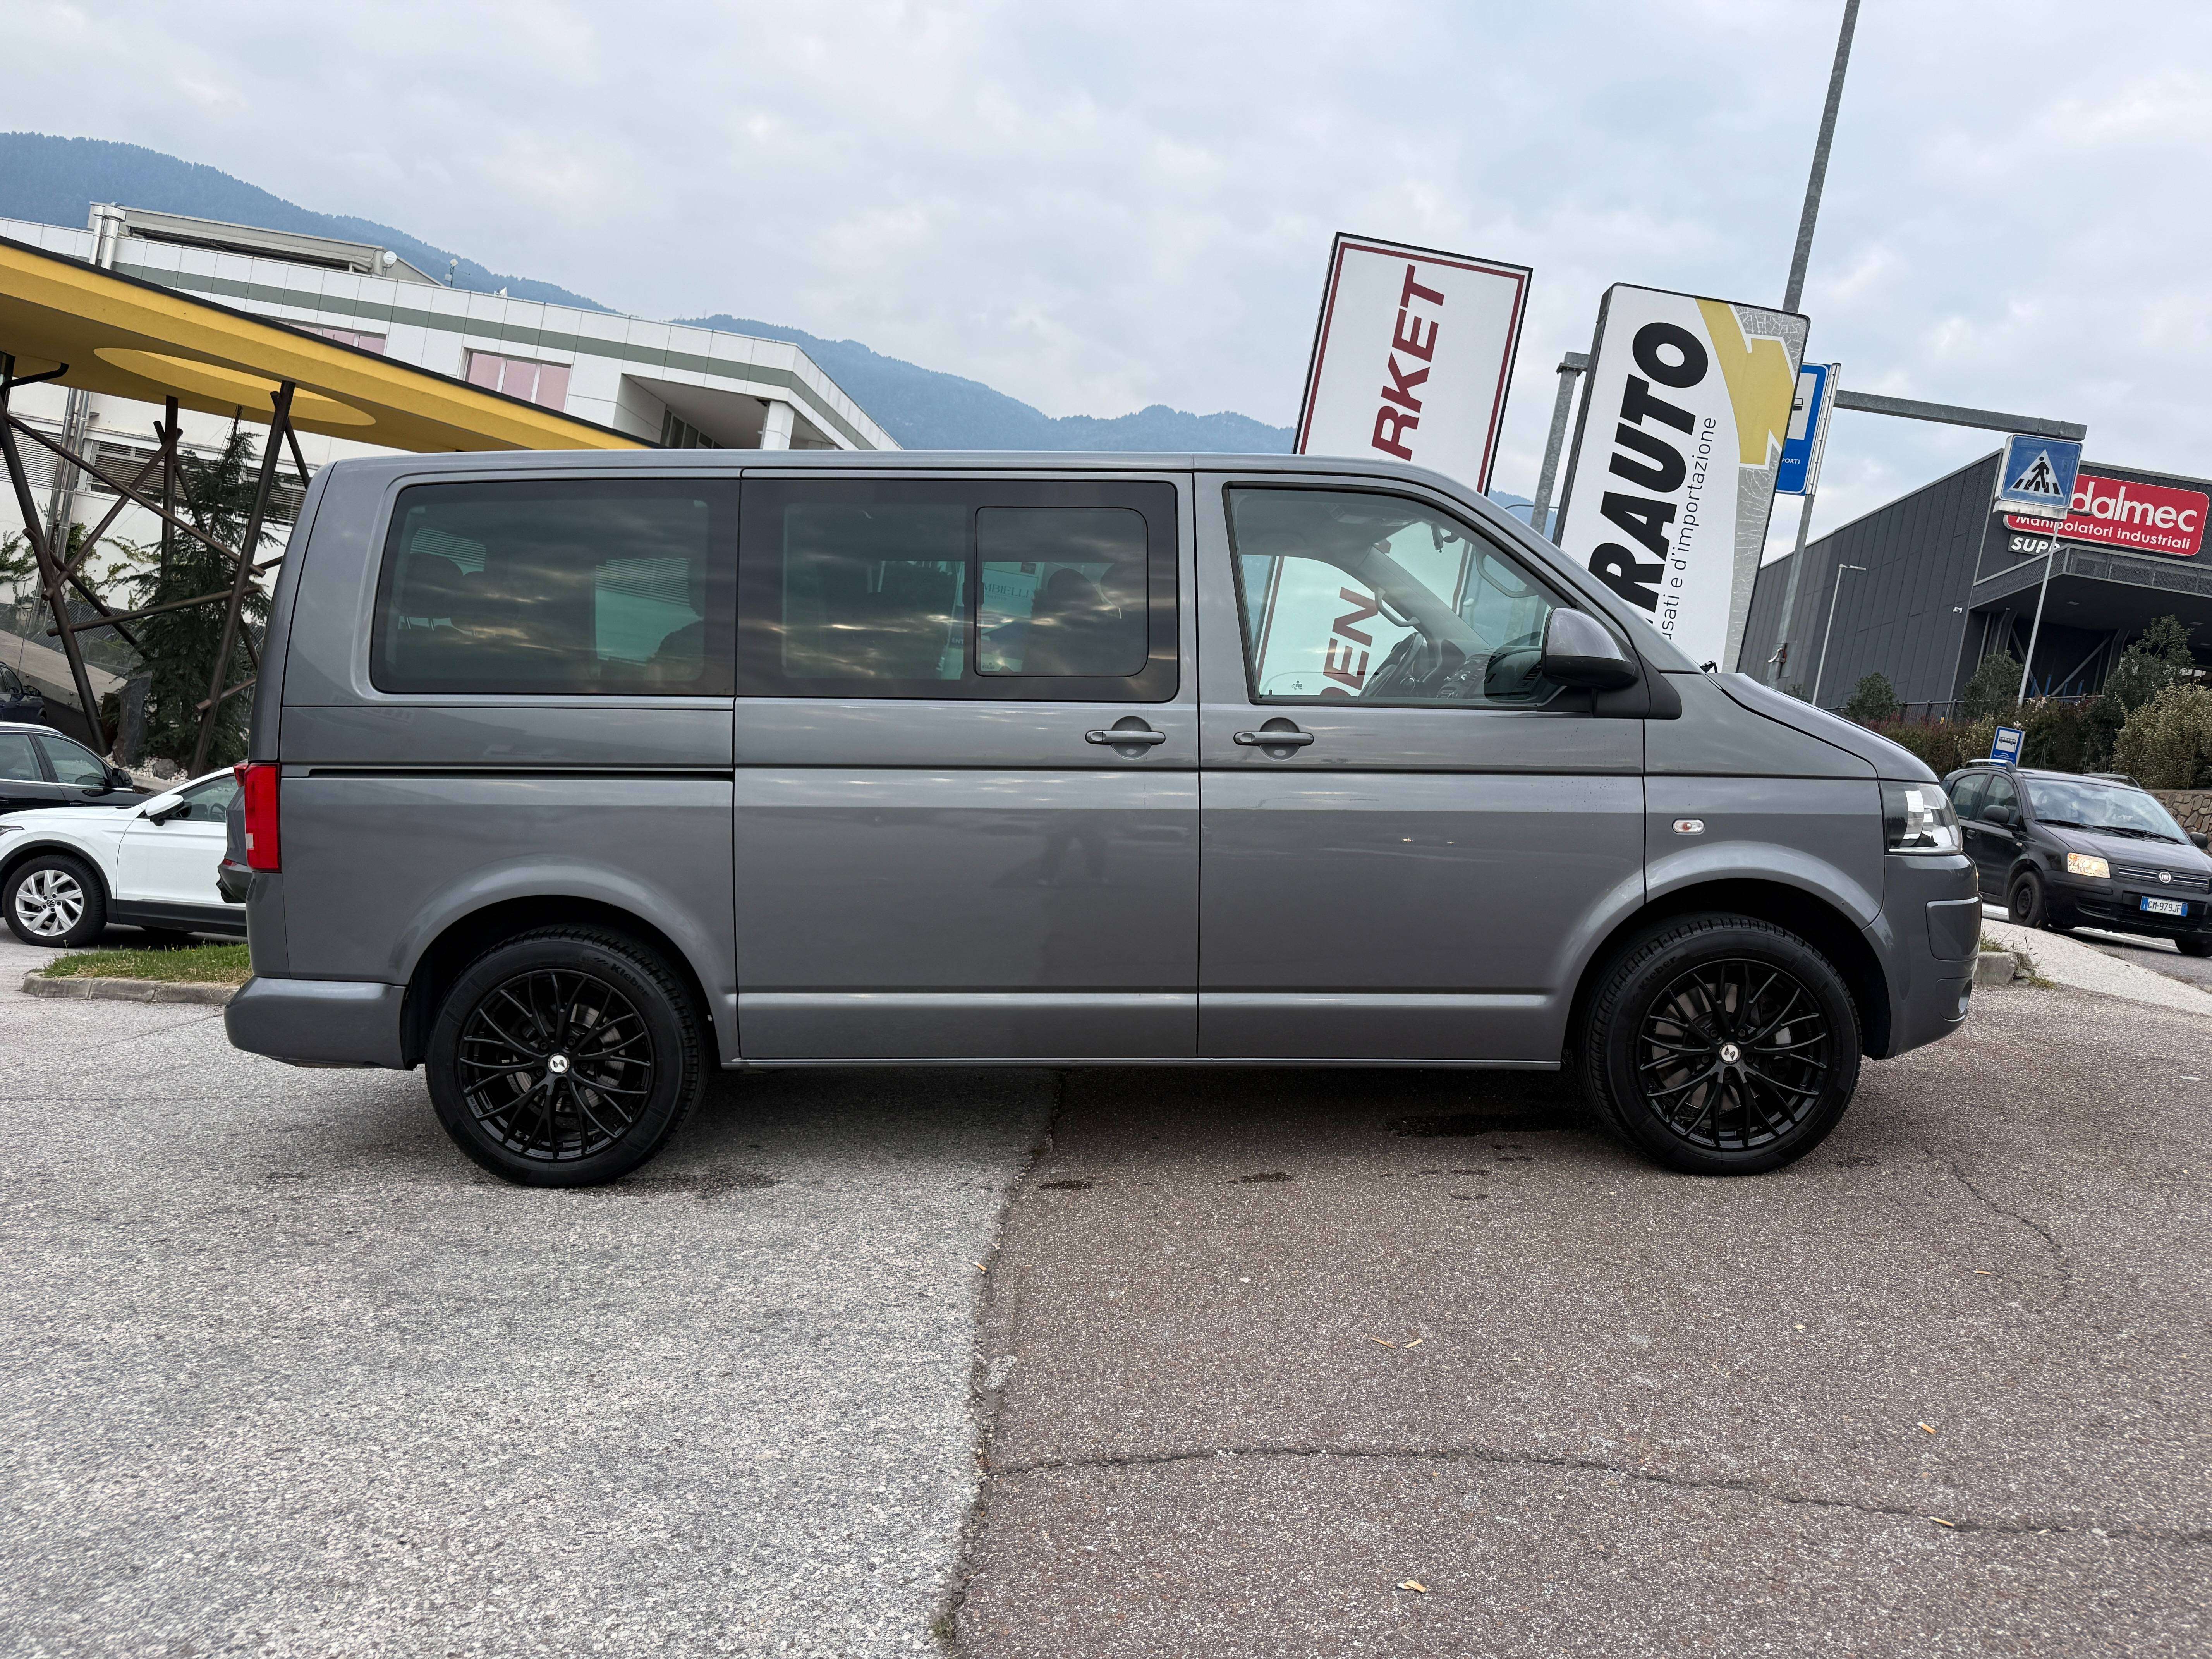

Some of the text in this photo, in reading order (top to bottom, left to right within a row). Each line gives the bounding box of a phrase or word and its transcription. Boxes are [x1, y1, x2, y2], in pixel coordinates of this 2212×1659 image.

[1587, 321, 1709, 625] RAUTO
[1670, 417, 1716, 570] d'importazione
[2070, 481, 2198, 532] dalmec
[2016, 516, 2191, 550] Manipolatori industriali
[1671, 577, 1683, 588] e
[1319, 586, 1379, 697] EN
[610, 963, 650, 996] Kleber
